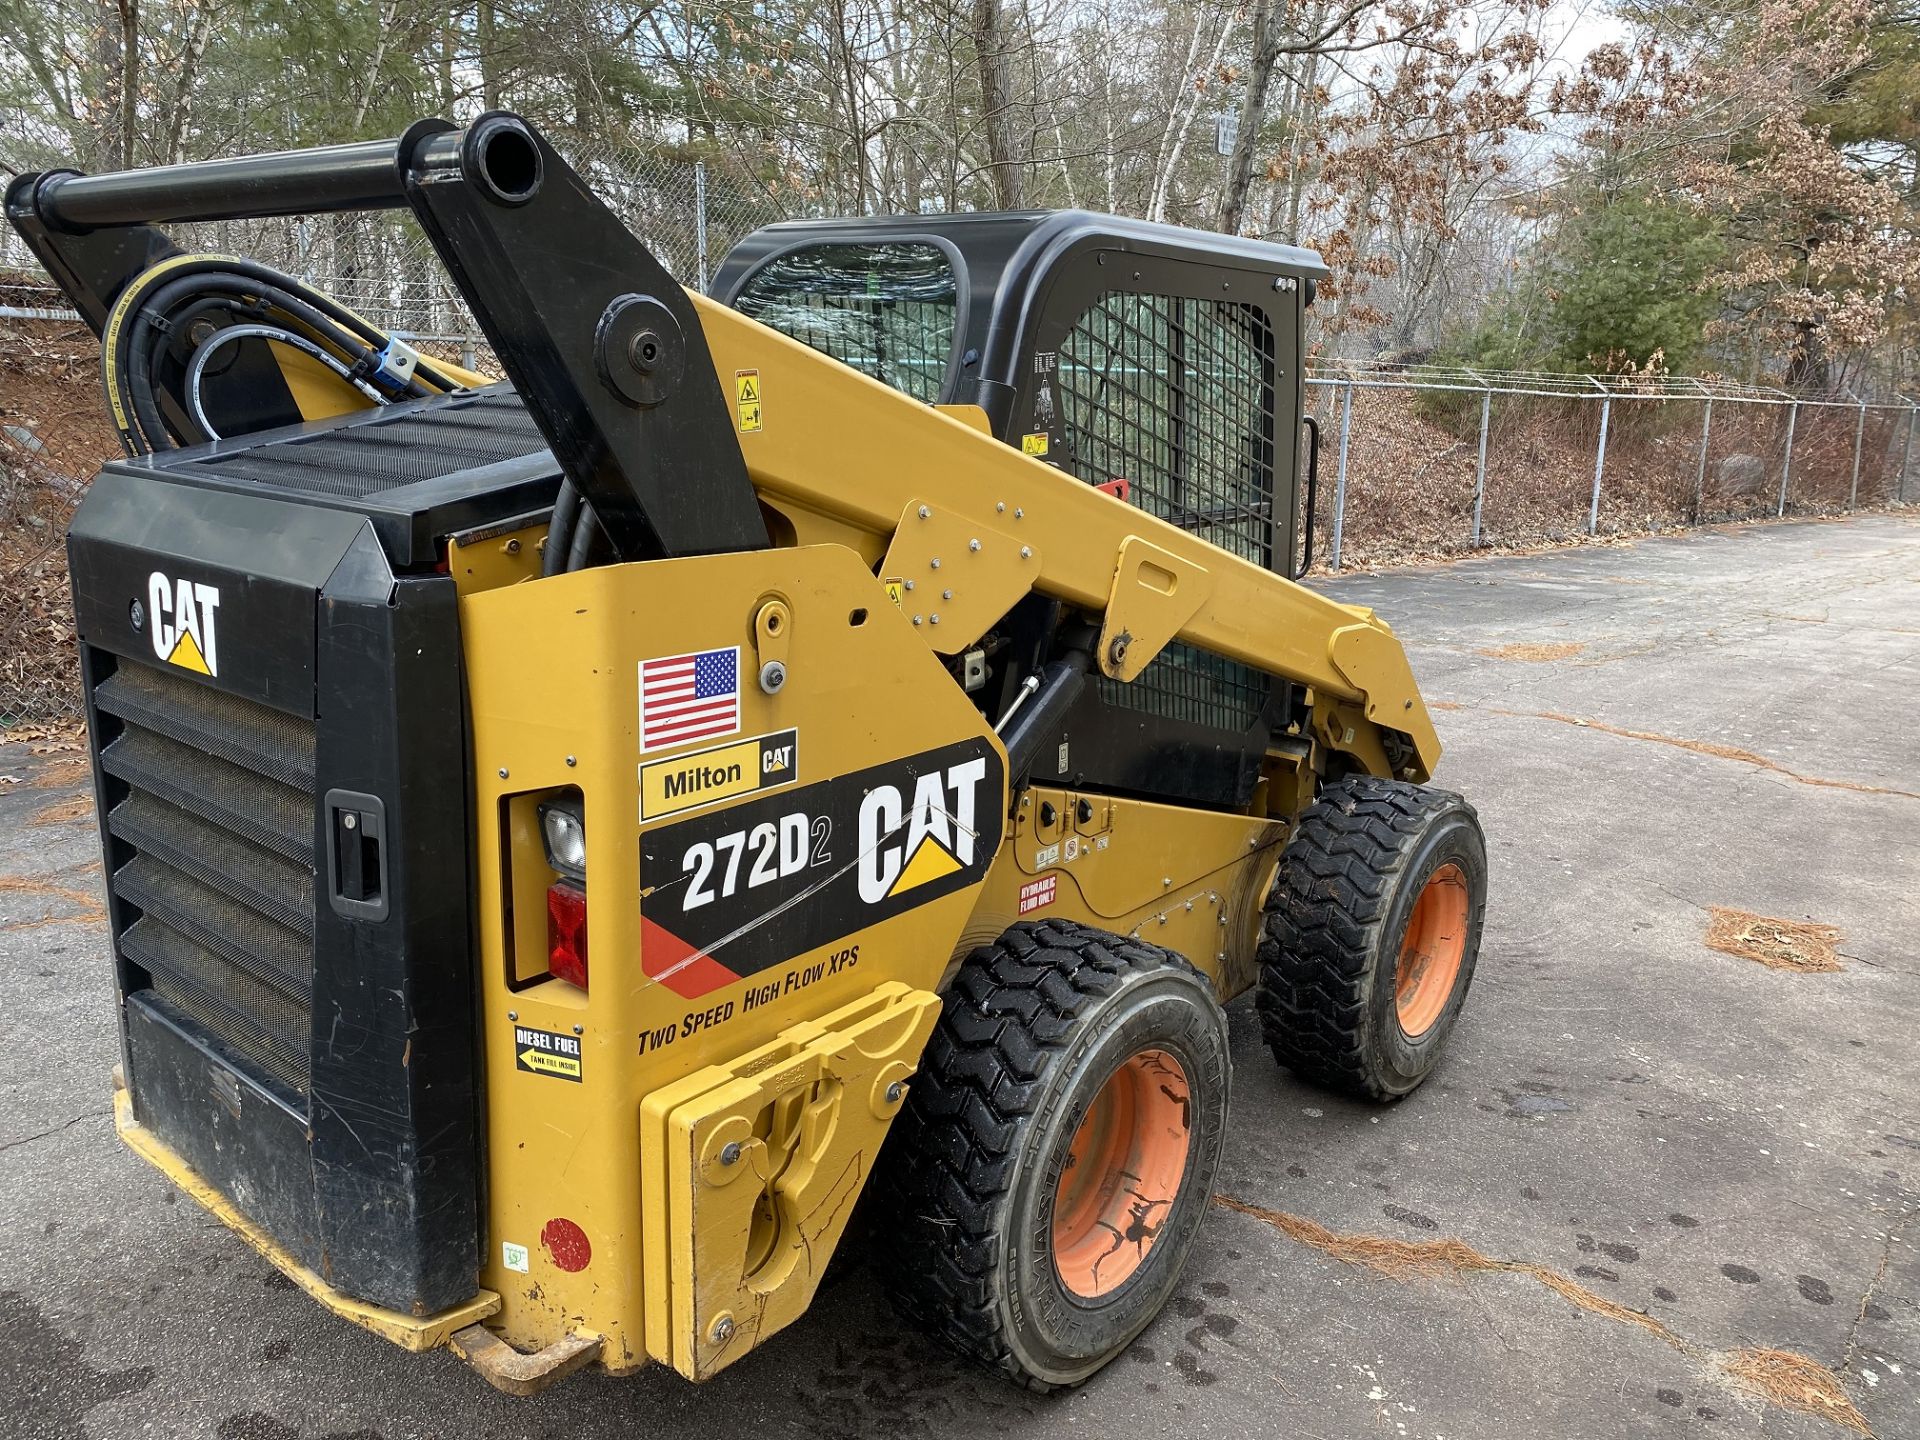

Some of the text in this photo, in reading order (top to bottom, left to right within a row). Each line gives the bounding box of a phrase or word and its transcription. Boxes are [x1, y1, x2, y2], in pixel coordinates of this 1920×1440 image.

[148, 571, 220, 678] CAT
[762, 745, 793, 774] CAT
[664, 764, 741, 799] Milton
[682, 757, 986, 912] 272D2 CAT
[1020, 889, 1056, 914] FLUID ONLY
[1021, 876, 1056, 900] HYDRAULIC
[827, 945, 859, 976] XPS
[516, 1029, 580, 1055] DIESEL FUEL
[530, 1055, 546, 1065] TANK
[558, 1061, 577, 1071] INSIDE
